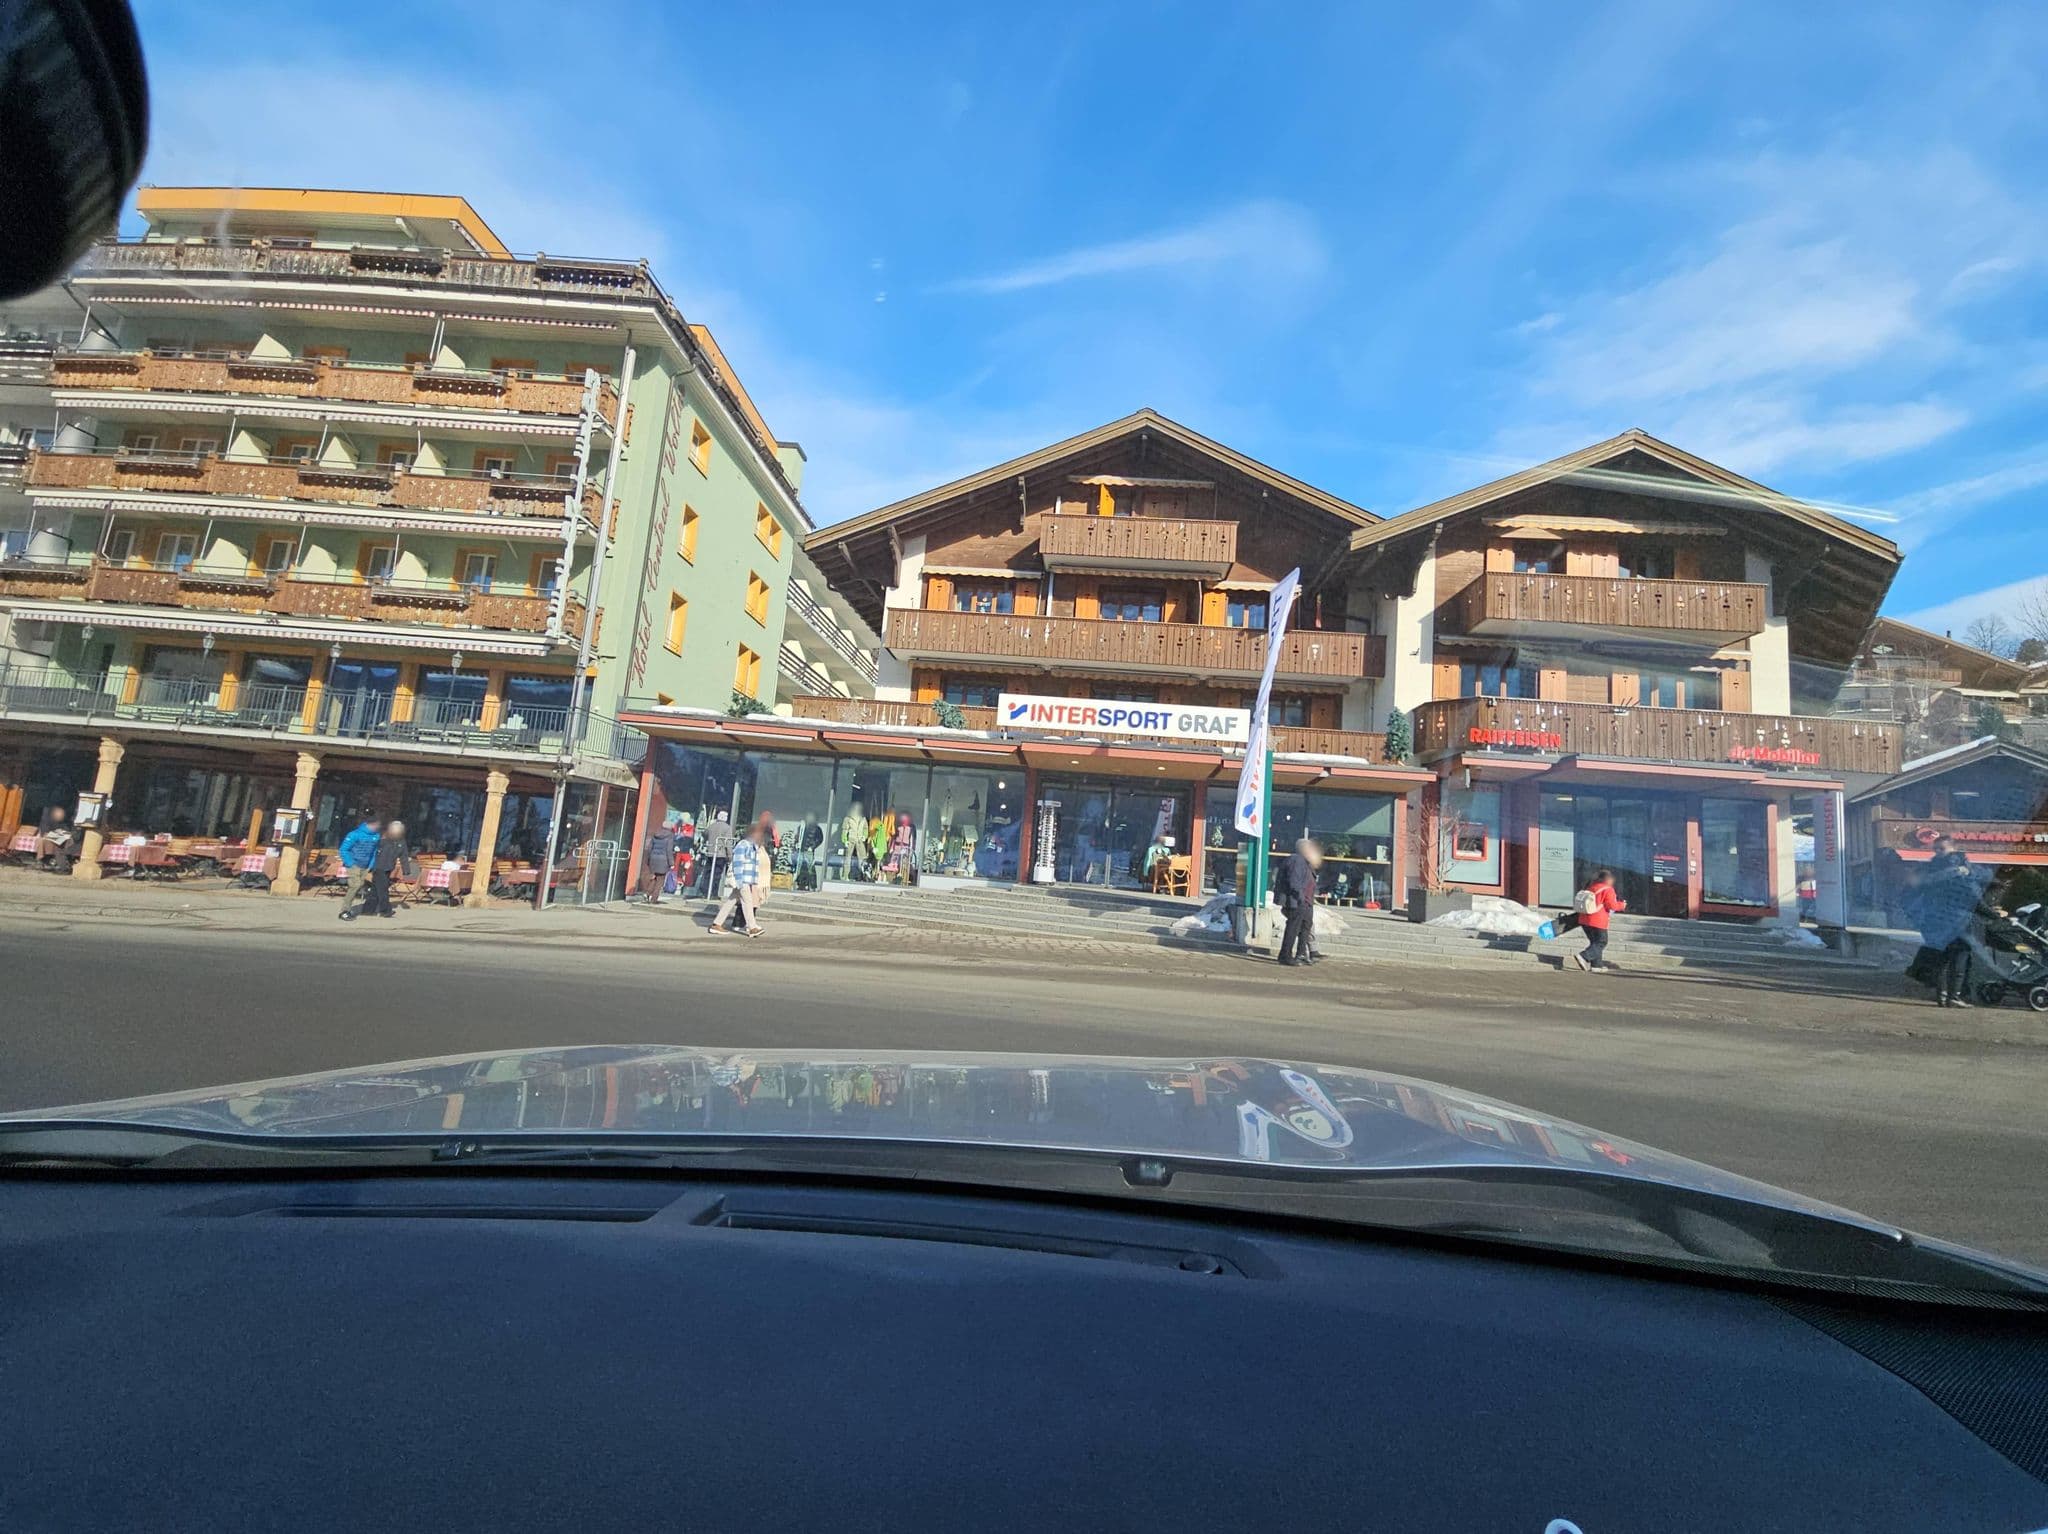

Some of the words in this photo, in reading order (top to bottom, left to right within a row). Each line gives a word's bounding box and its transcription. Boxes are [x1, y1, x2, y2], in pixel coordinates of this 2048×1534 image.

[632, 600, 653, 689] Hotel
[646, 477, 670, 593] Central
[1030, 703, 1173, 731] INTERSPORT
[1178, 713, 1238, 735] GRAF
[1470, 727, 1561, 748] RAIFFEISEN
